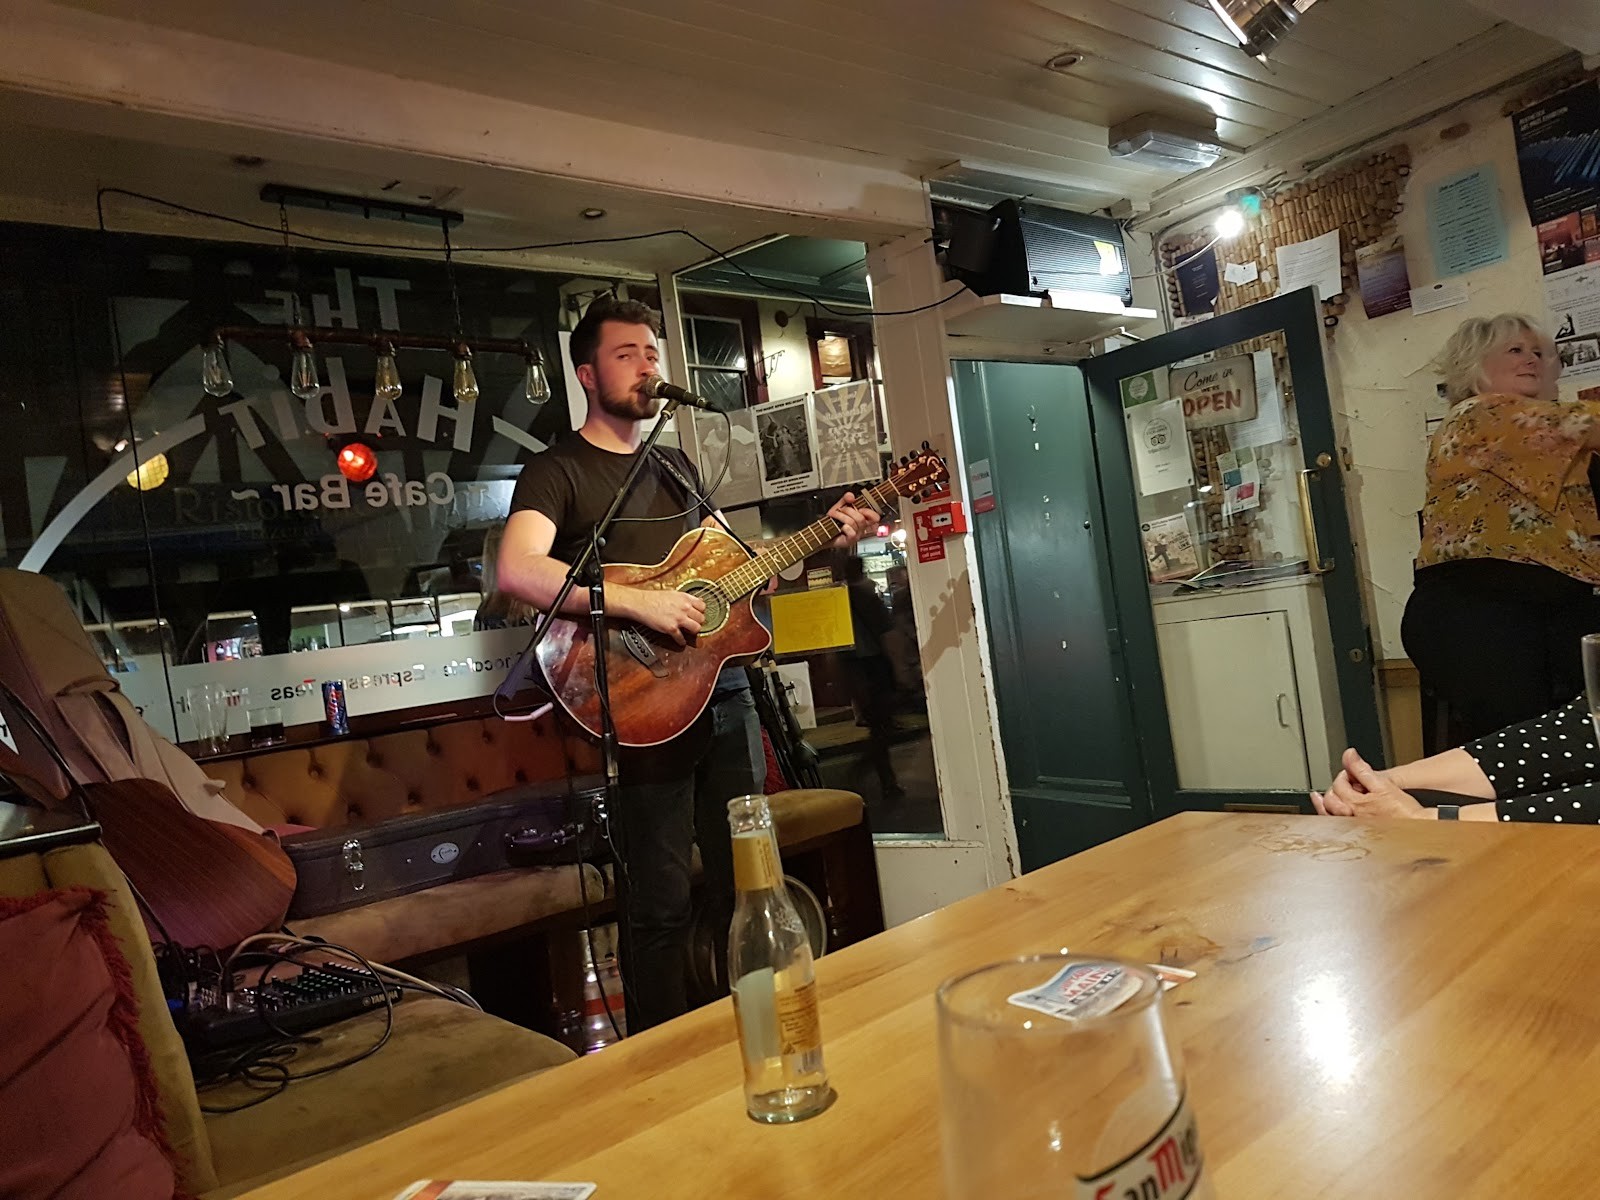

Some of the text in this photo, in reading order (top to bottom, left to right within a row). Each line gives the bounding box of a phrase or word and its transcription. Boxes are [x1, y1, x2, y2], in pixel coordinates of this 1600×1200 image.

[1184, 367, 1235, 391] Come in
[1183, 388, 1241, 417] OPEN
